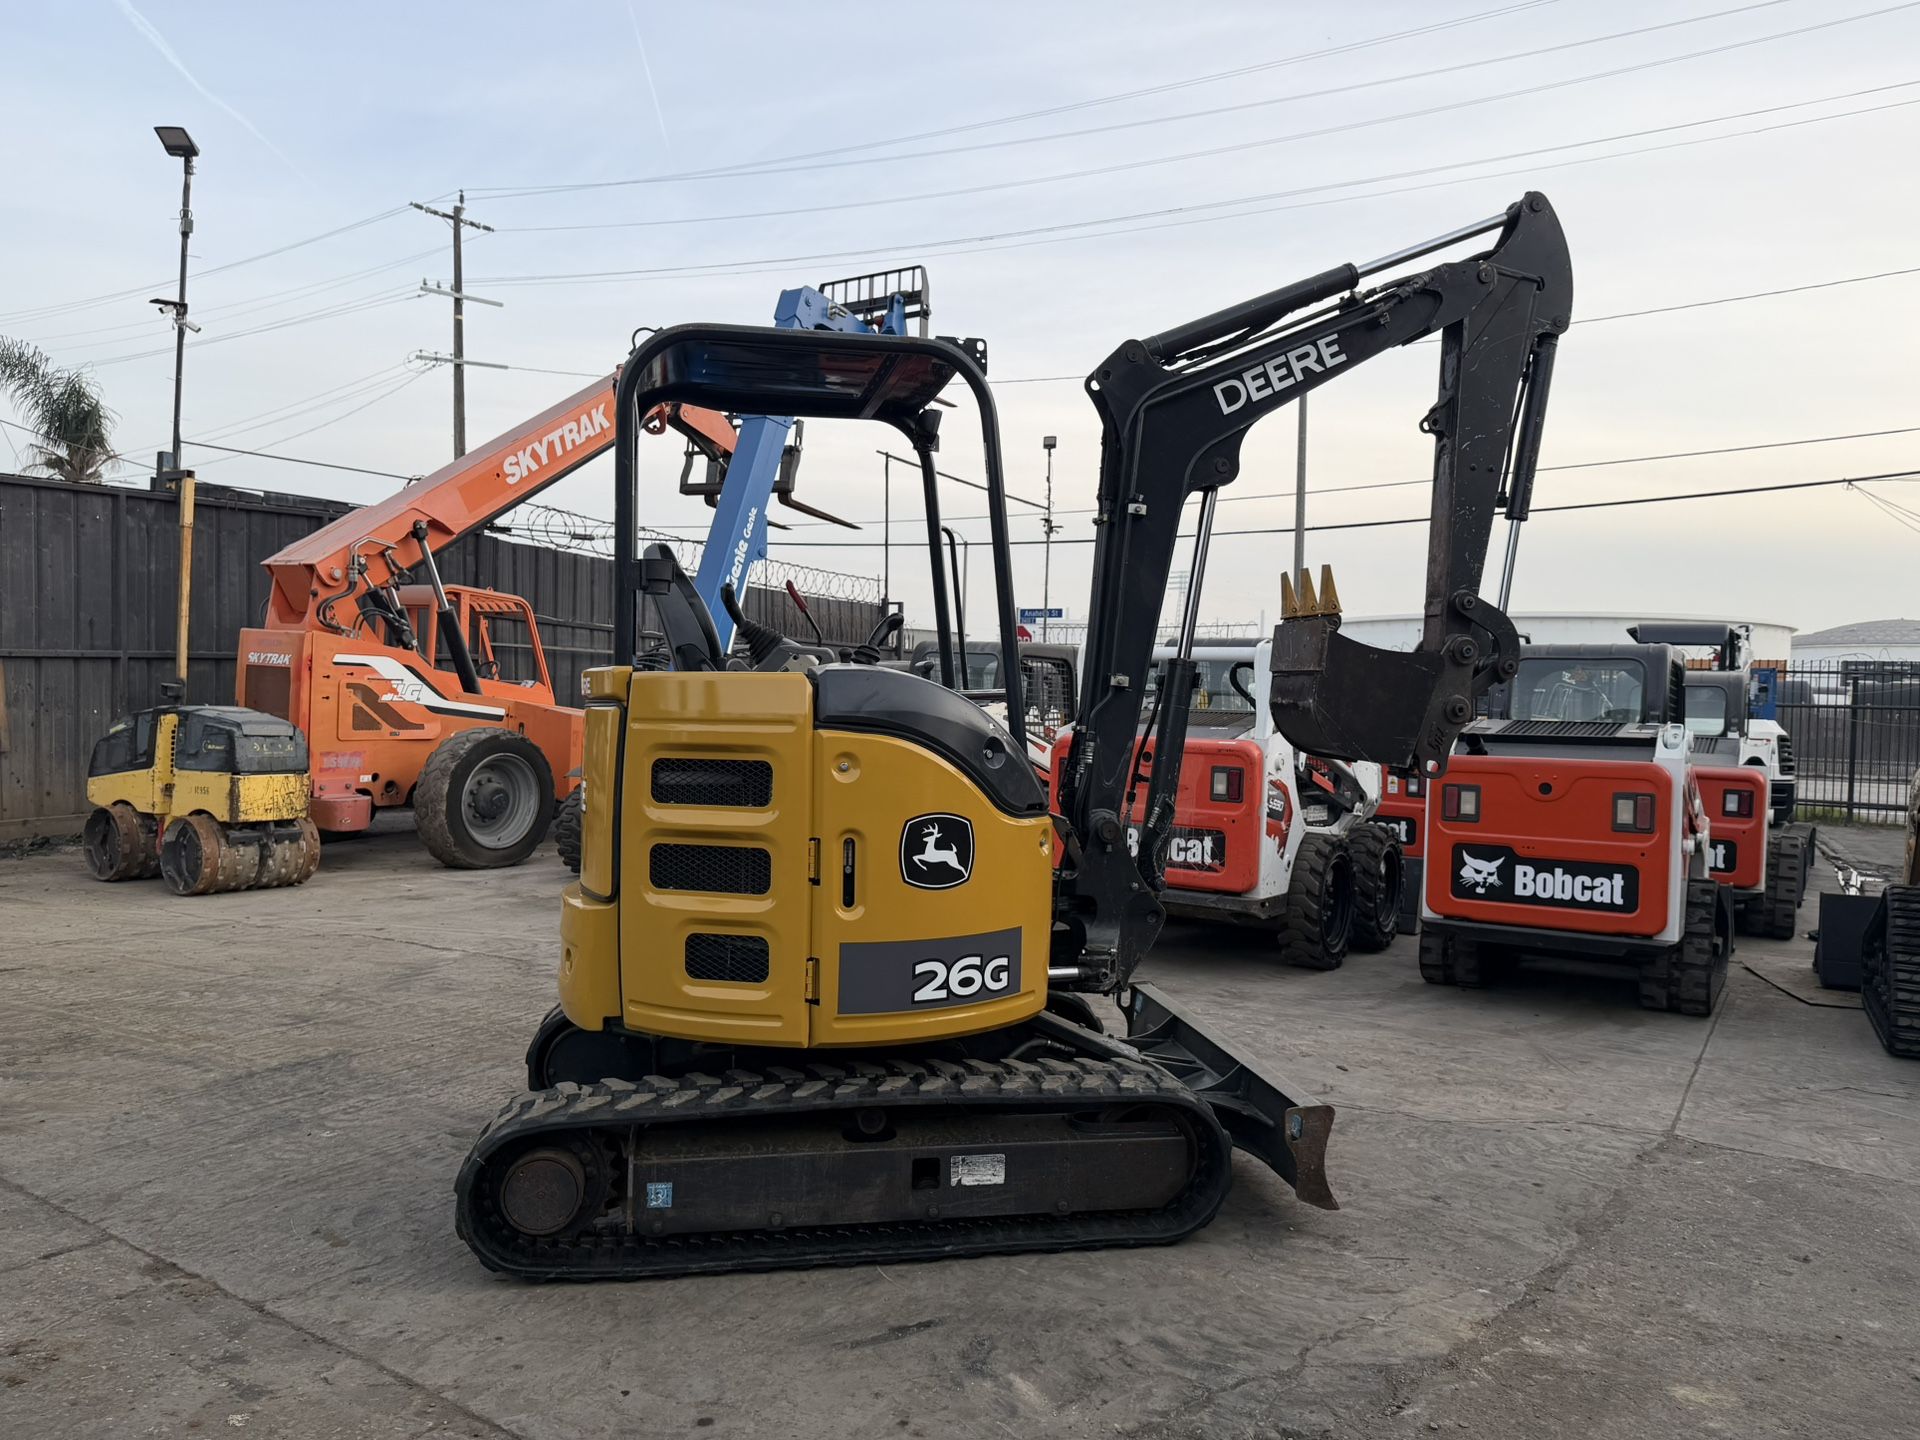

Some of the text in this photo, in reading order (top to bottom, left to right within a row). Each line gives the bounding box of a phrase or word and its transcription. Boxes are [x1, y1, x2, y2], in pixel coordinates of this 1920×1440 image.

[1213, 333, 1347, 415] DEERE
[503, 403, 610, 485] SKYTRAK
[743, 506, 758, 539] Genie
[248, 651, 292, 665] SKYTRAK
[1127, 828, 1213, 866] Bcat
[1514, 864, 1625, 905] Bobcat
[913, 956, 1009, 1002] 26G
